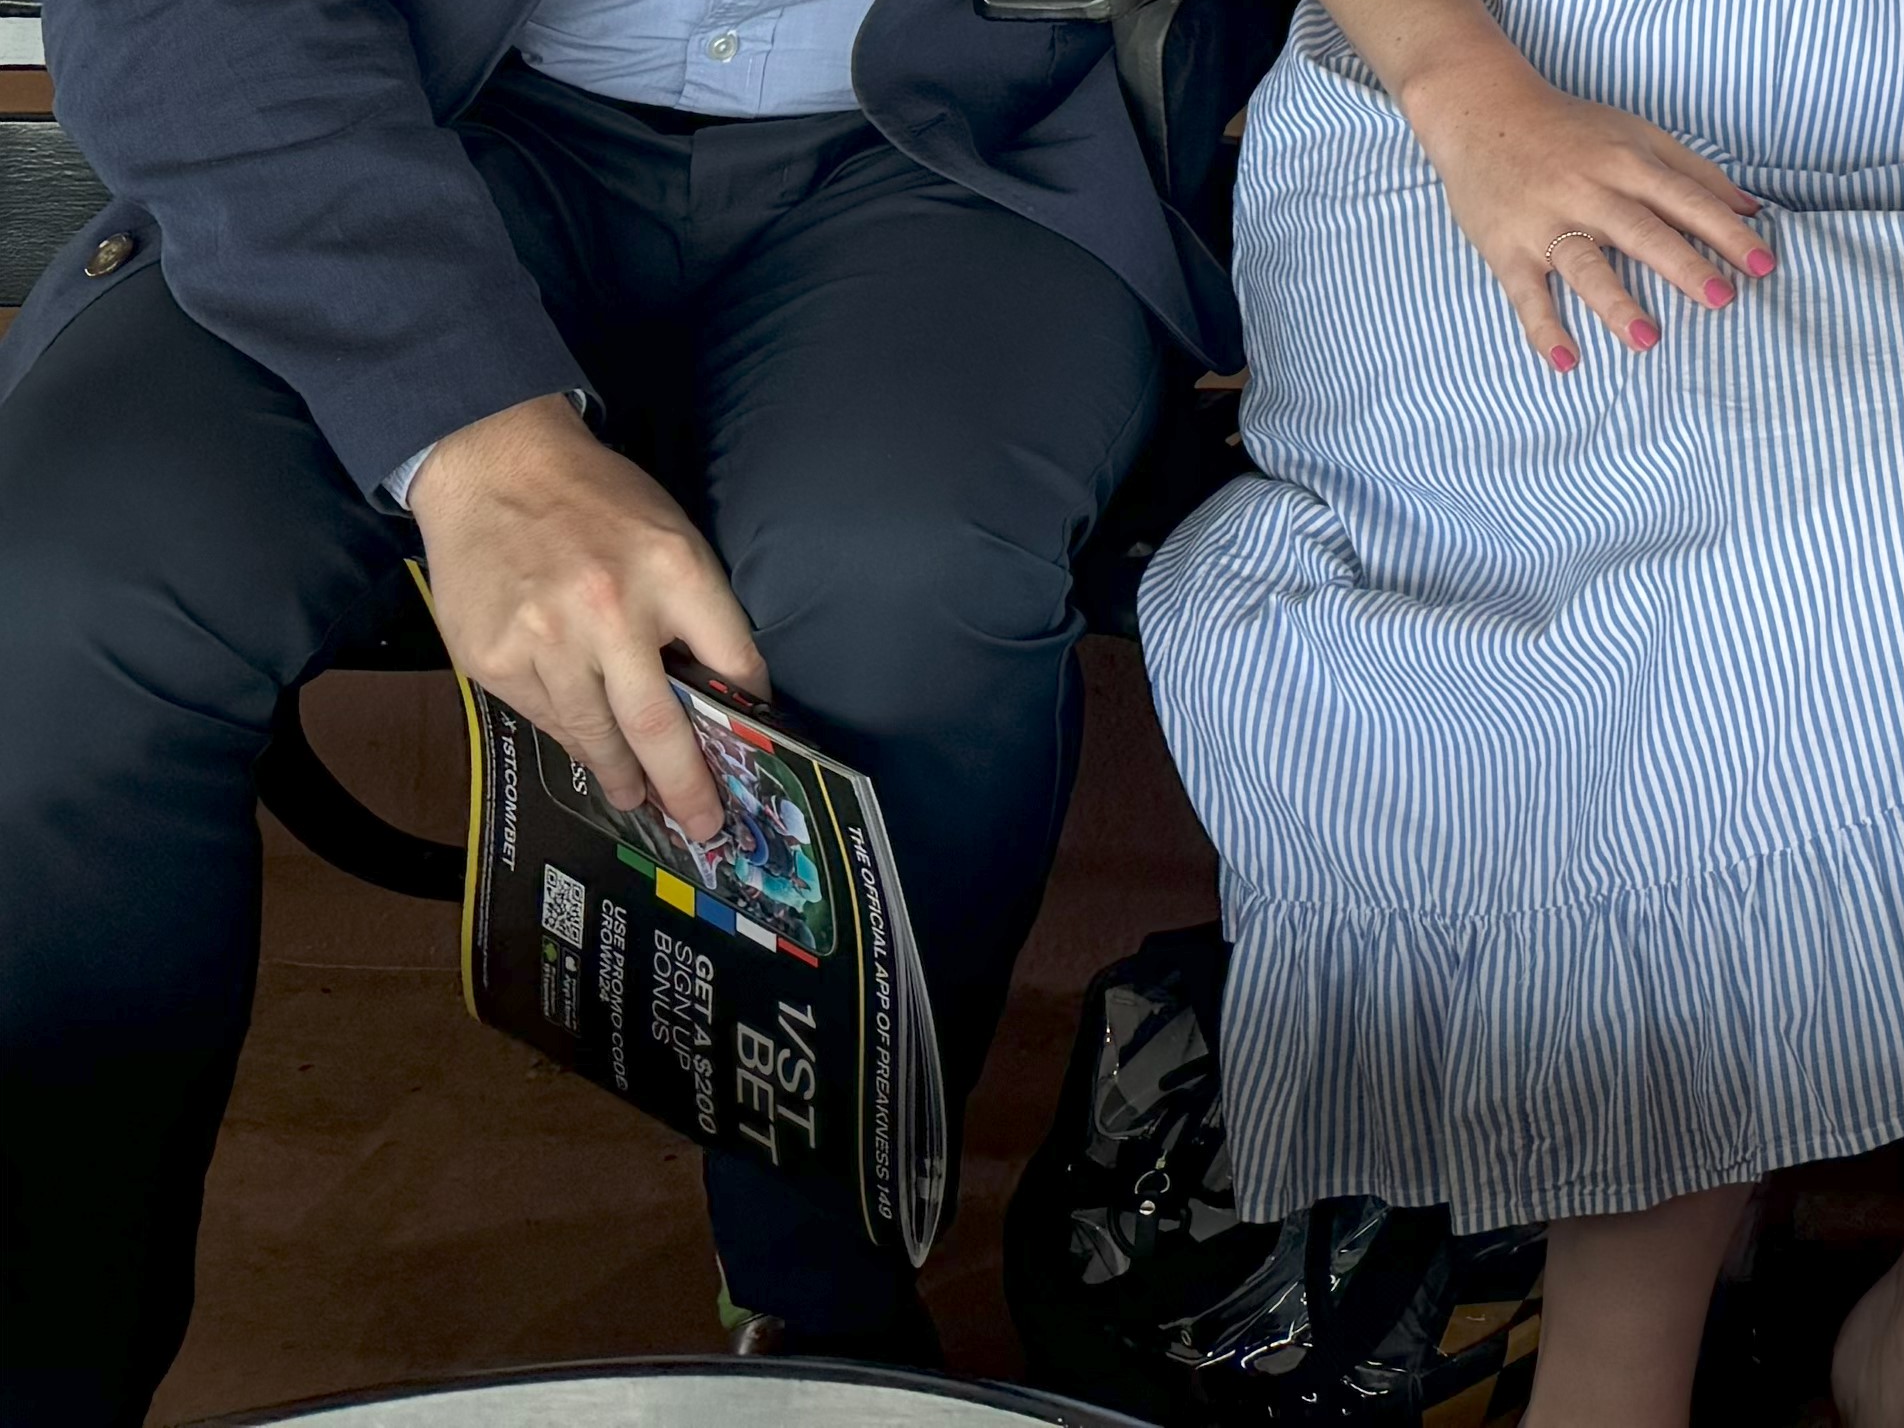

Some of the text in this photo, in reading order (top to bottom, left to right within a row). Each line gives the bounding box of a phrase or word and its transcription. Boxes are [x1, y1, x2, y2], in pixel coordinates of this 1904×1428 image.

[597, 898, 615, 1003] CROWN24
[609, 951, 626, 1029] PROMO
[612, 905, 628, 948] USE
[651, 929, 674, 1046] BONUS
[671, 939, 694, 1072] SIGN UP
[692, 952, 719, 1135] GET A $200
[846, 825, 893, 1220] THE OFFICIAL APP OF PREAKNESS 149
[736, 1021, 780, 1168] BET
[776, 1000, 818, 1150] 1/ST
